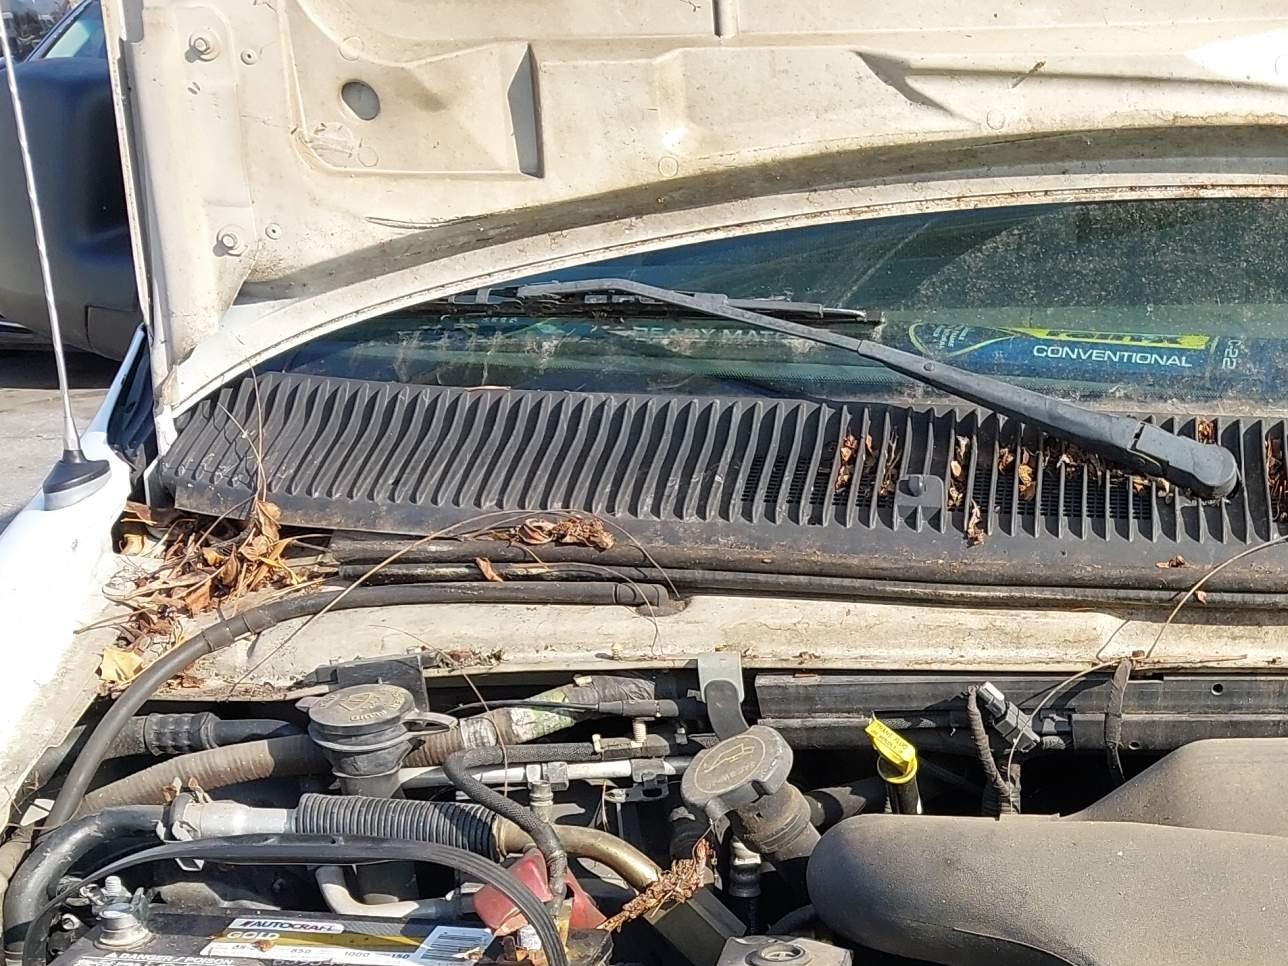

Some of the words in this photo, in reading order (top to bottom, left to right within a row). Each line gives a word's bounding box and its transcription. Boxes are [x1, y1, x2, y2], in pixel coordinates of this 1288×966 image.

[1032, 345, 1193, 367] CONVENTIONAL
[227, 930, 281, 940] GOLD
[119, 952, 177, 963] DANGER
[185, 956, 234, 966] POISON
